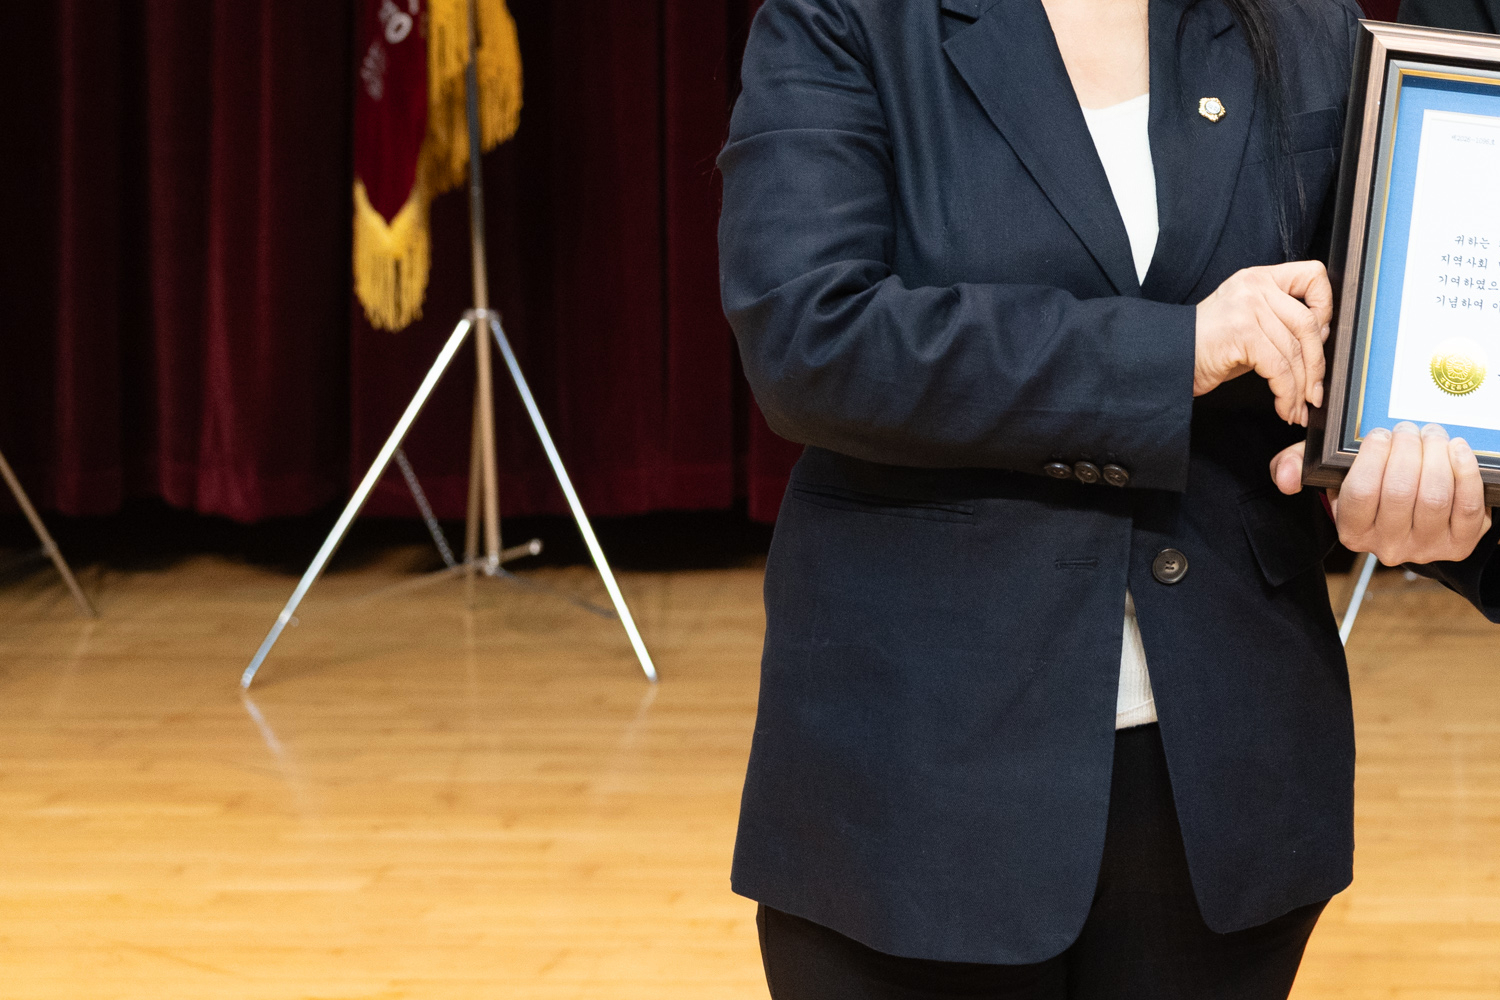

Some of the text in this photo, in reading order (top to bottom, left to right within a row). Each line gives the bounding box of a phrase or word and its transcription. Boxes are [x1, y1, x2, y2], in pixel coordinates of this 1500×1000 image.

[1454, 234, 1490, 250] 귀하는
[1440, 253, 1488, 269] 지역사회
[1436, 295, 1484, 310] 기념하여
